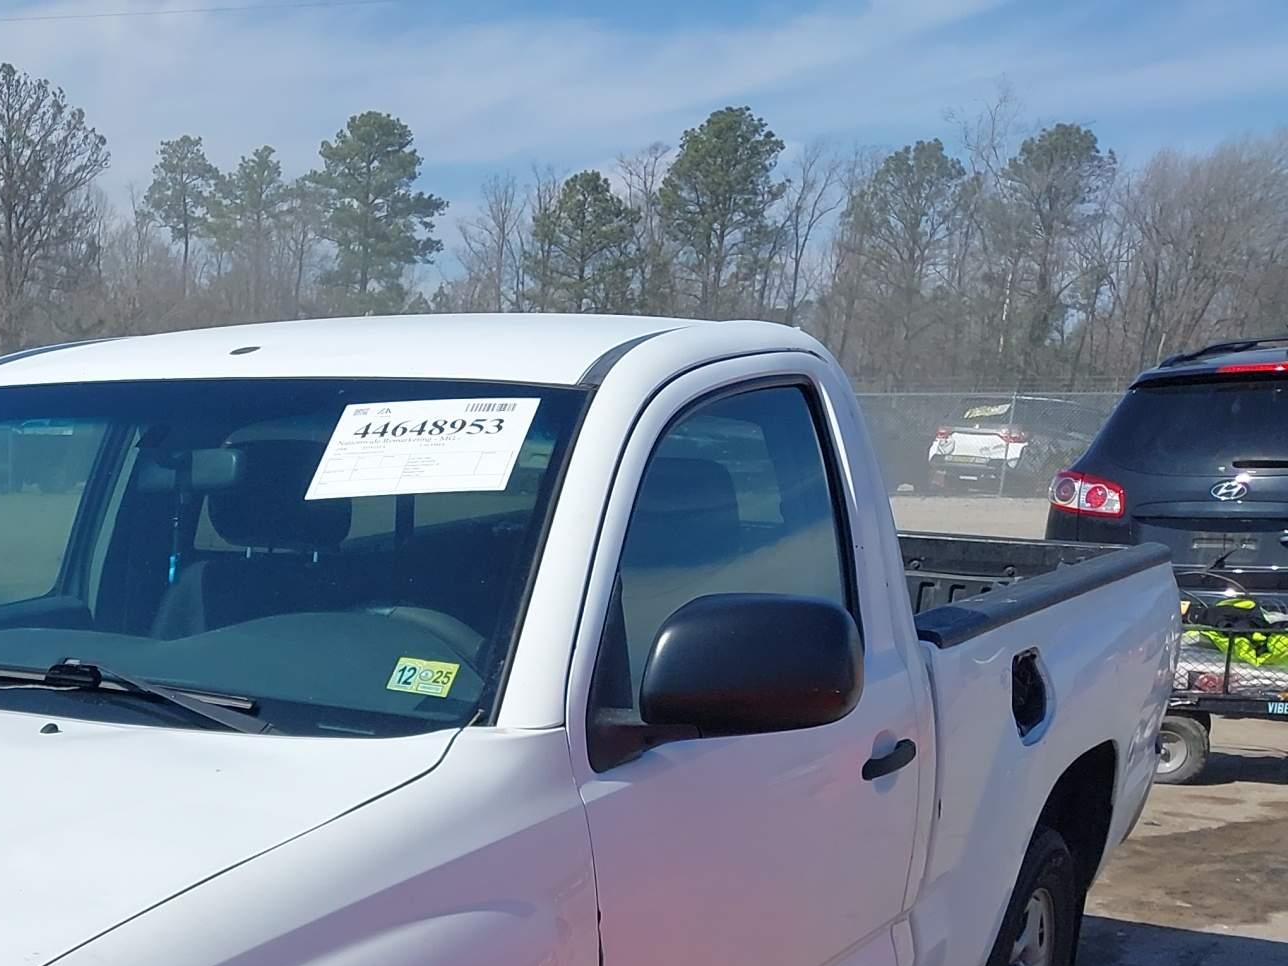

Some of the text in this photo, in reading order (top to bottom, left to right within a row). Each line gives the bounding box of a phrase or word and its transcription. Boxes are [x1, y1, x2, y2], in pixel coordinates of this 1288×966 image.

[353, 418, 505, 439] 44648953
[397, 665, 453, 685] 12 25
